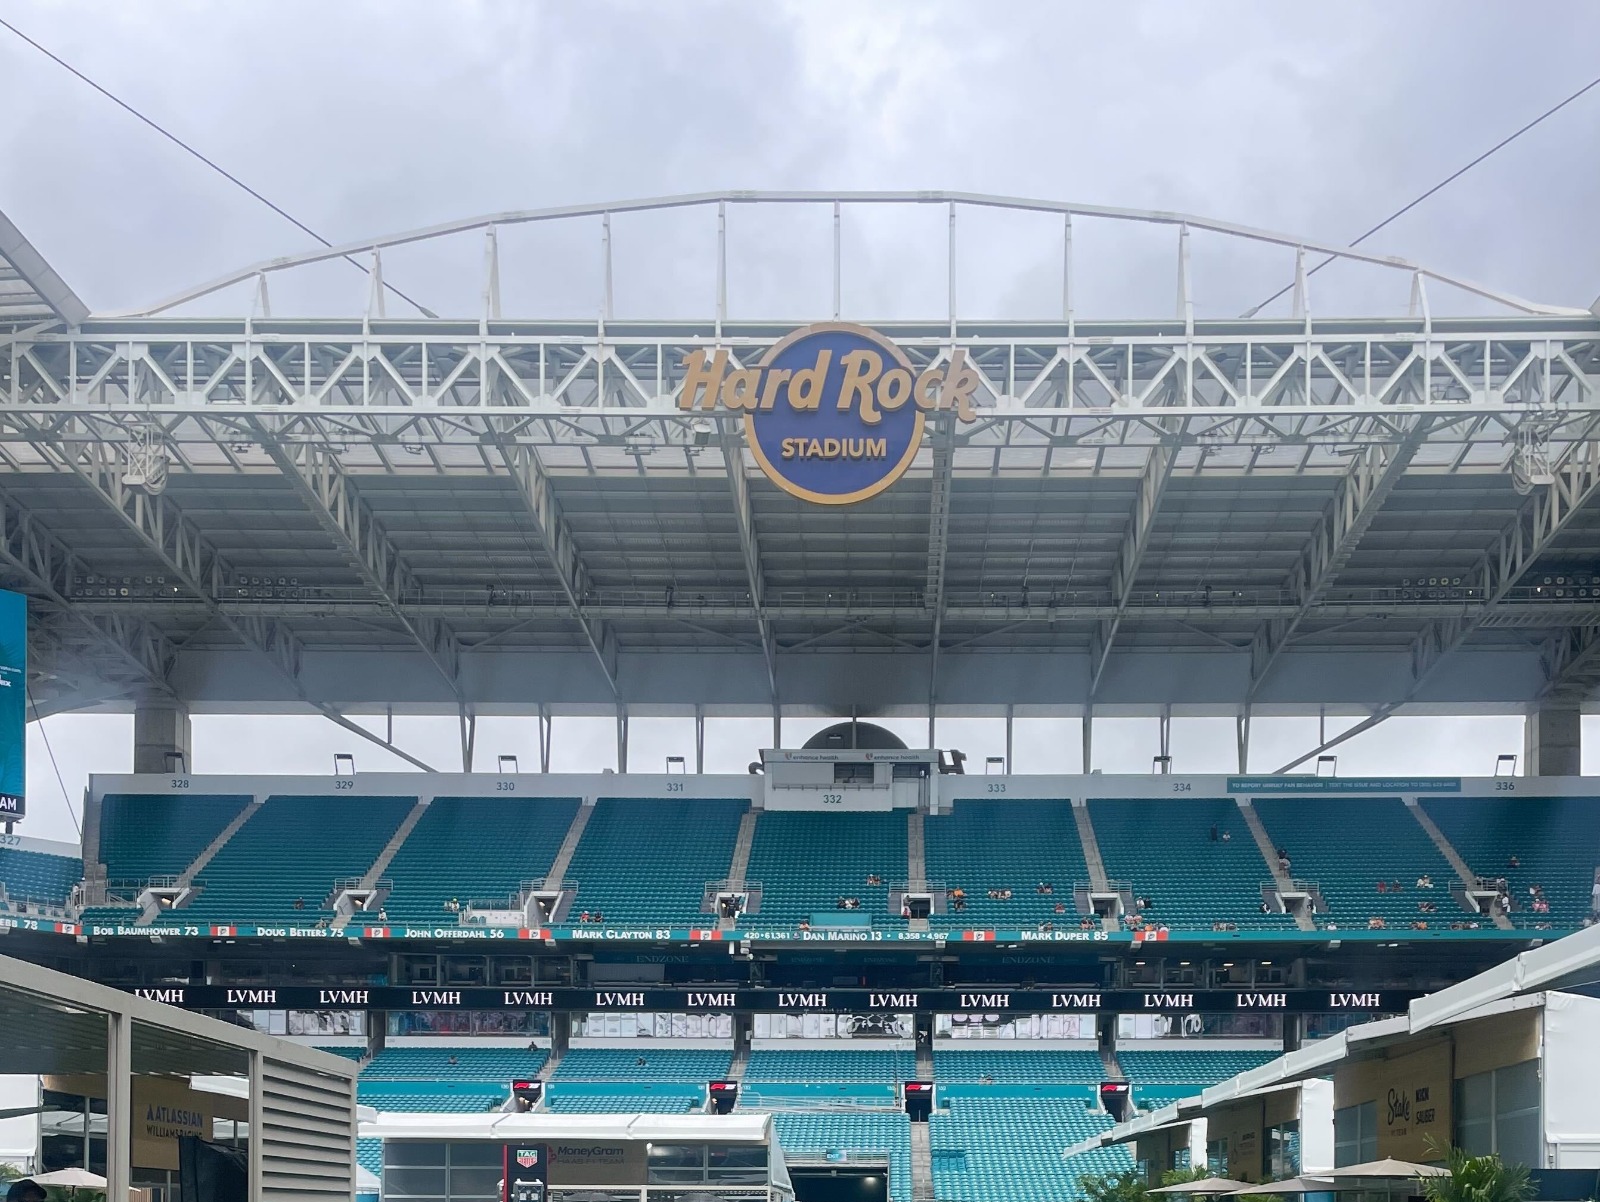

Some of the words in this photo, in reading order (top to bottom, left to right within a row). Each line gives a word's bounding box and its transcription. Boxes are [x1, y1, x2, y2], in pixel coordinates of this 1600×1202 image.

[679, 349, 832, 411] Hard
[836, 349, 980, 425] Rock
[781, 437, 887, 459] STADIUM
[171, 779, 189, 789] 328
[335, 780, 353, 790] 329
[496, 781, 515, 792] 330
[666, 782, 684, 793] 331
[987, 783, 1006, 794] 333
[1173, 782, 1192, 793] 334
[1495, 781, 1514, 792] 336
[823, 794, 842, 804] 332
[0, 835, 21, 846] 327
[0, 918, 18, 928] EBB
[23, 919, 38, 931] 78
[184, 926, 199, 936] 73
[330, 928, 344, 937] 75
[490, 929, 504, 939] 56
[655, 929, 671, 939] 83
[870, 931, 882, 941] 13
[1093, 931, 1108, 941] 85
[227, 990, 276, 1003] LVMH
[320, 990, 369, 1004] LVMH
[412, 991, 461, 1005] LVMH
[504, 992, 553, 1006] LVMH
[596, 993, 645, 1006] LVMH
[688, 993, 736, 1007] LVMH
[778, 993, 827, 1007] LVMH
[870, 994, 918, 1007] LVMH
[960, 994, 1010, 1007] LVMH
[1052, 994, 1101, 1007] LVMH
[1144, 994, 1194, 1007] LVMH
[1237, 994, 1287, 1007] LVMH
[1330, 993, 1380, 1007] LVMH
[1387, 1088, 1410, 1125] Stake
[155, 1105, 203, 1128] ATLASSIAN
[558, 1146, 624, 1158] MoneyGram
